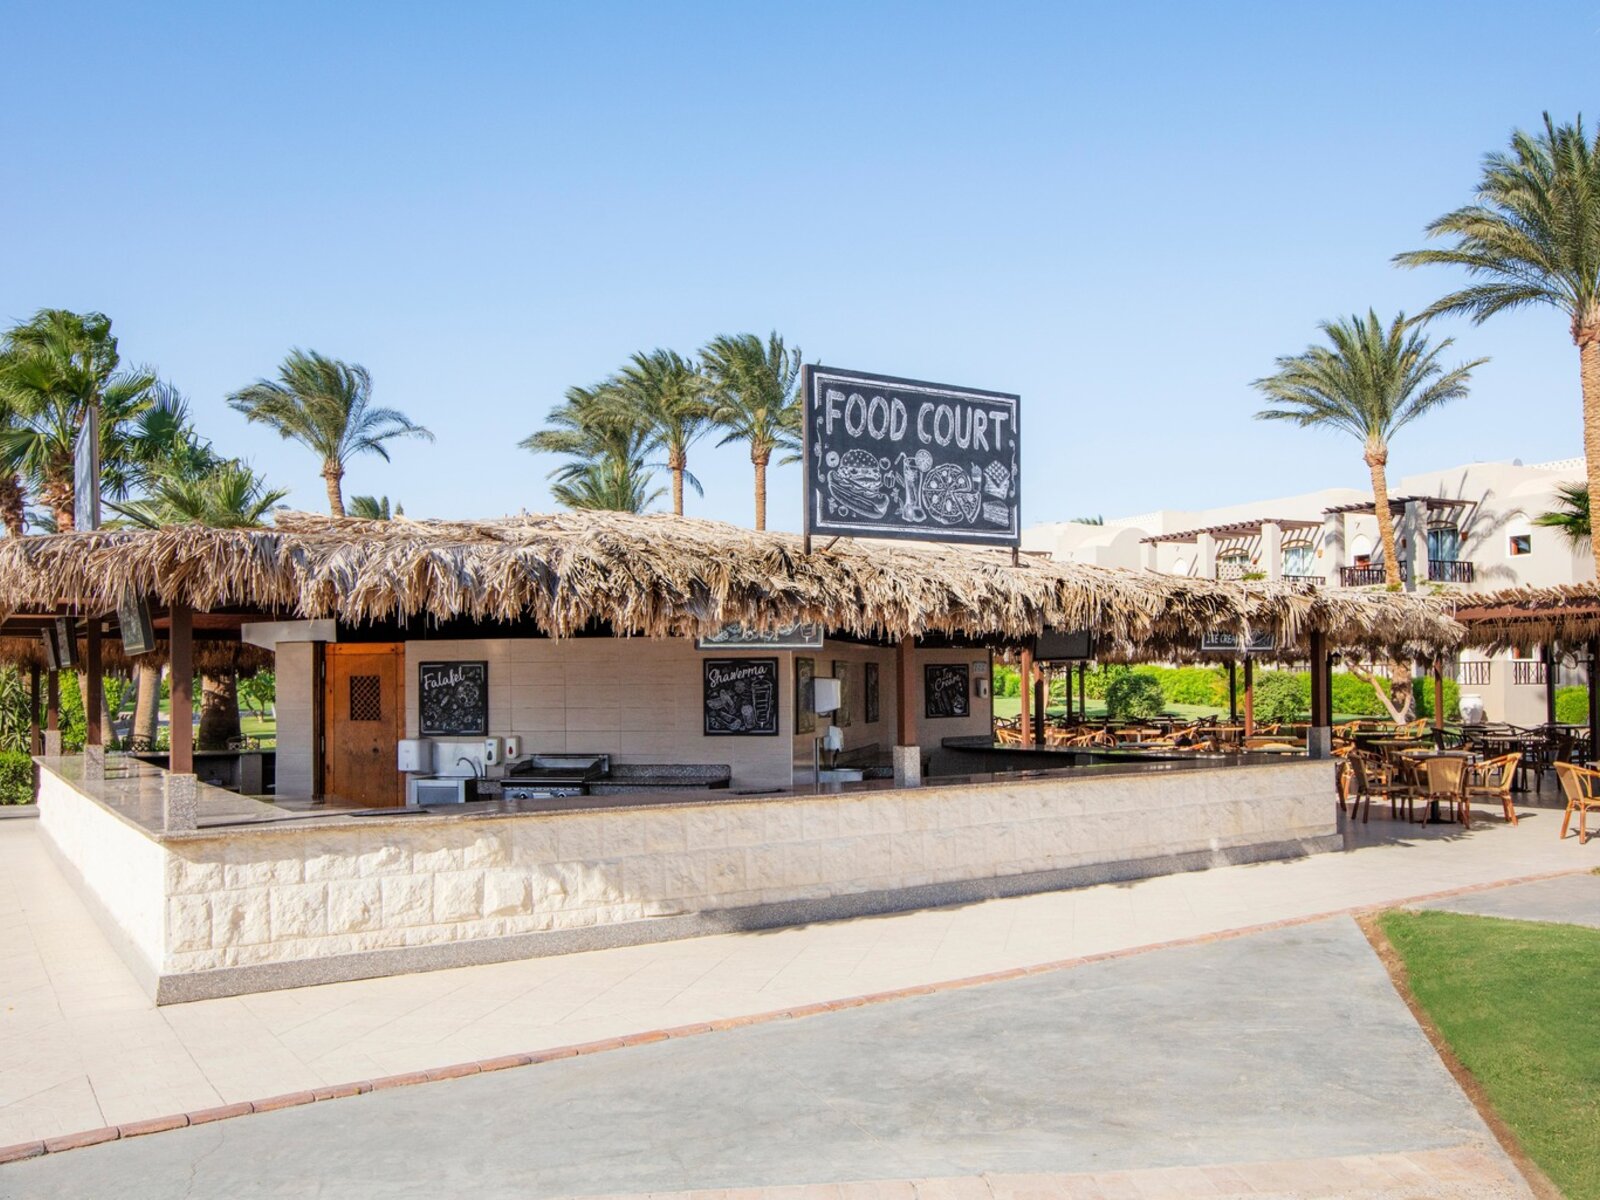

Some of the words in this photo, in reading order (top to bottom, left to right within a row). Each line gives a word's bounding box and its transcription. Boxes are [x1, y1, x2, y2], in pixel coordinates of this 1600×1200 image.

[825, 389, 908, 442] FOOD
[917, 402, 1009, 452] COURT
[423, 666, 466, 691] Falafel
[708, 665, 768, 688] Shawerma
[935, 674, 962, 692] Cream
